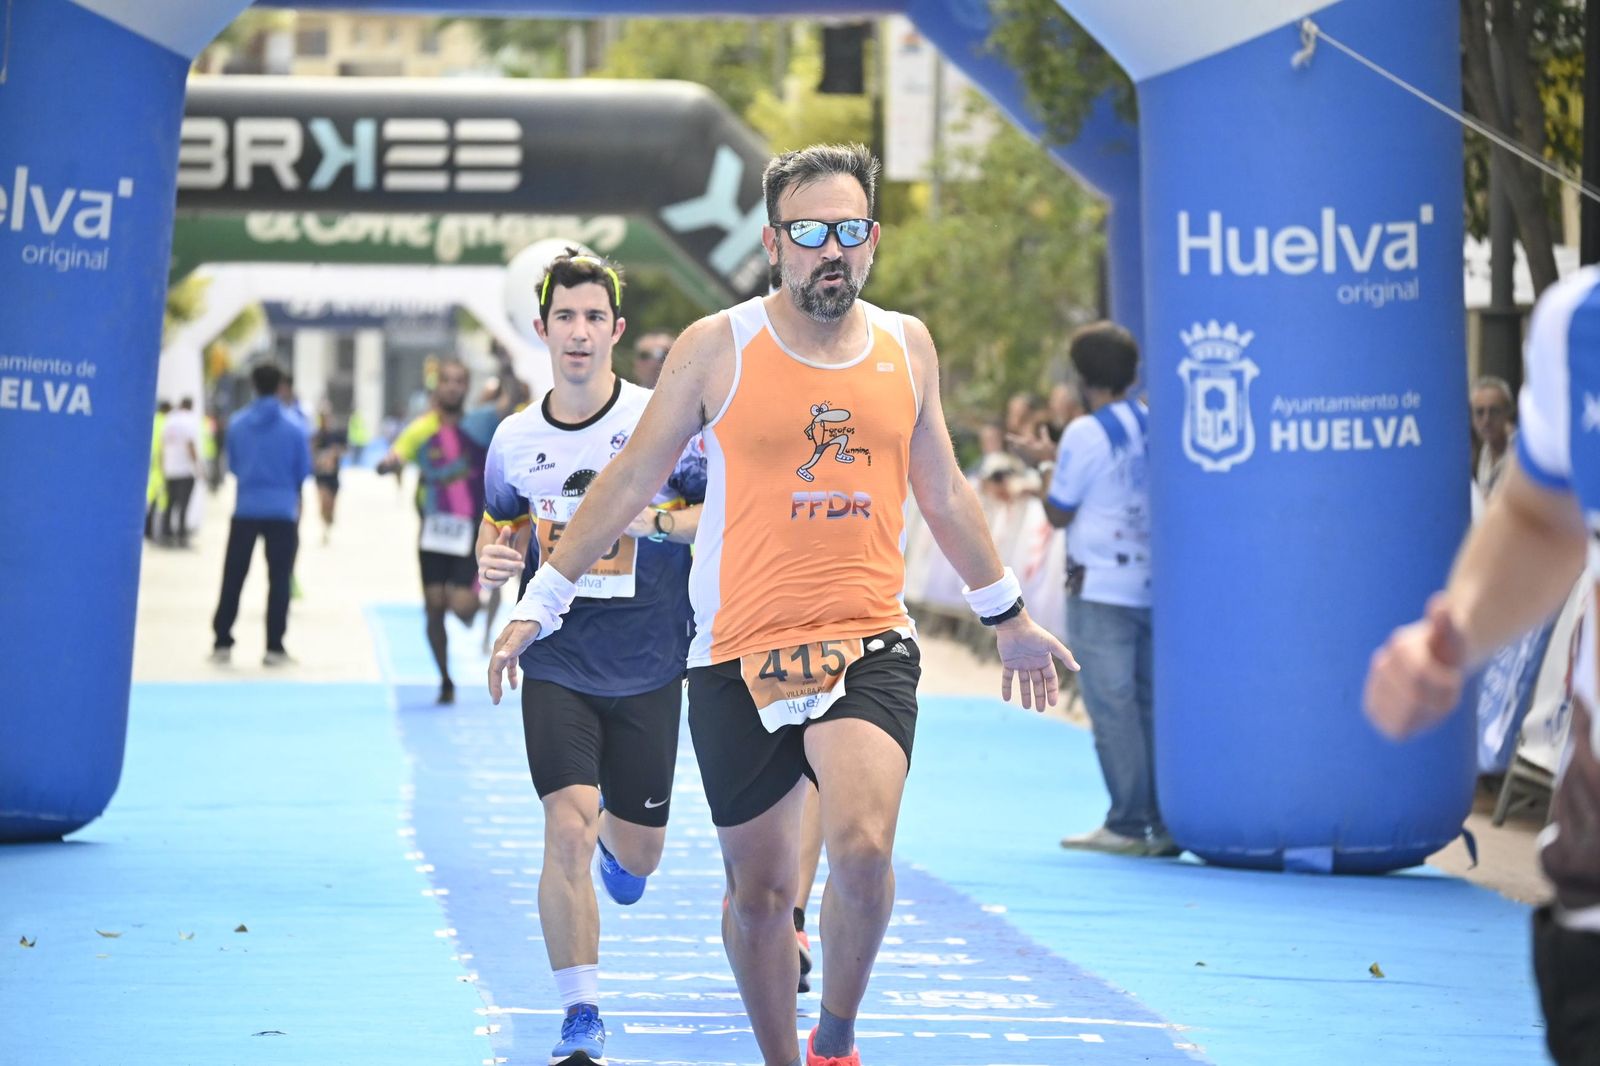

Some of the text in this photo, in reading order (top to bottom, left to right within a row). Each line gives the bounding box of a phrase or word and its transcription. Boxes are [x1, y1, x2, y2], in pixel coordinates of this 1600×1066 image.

[0, 166, 113, 241] lva
[1177, 206, 1419, 276] Huelva
[22, 243, 110, 273] original
[1337, 277, 1419, 308] original
[76, 359, 97, 379] de
[1271, 390, 1421, 417] Ayuntamiento de
[1270, 415, 1421, 452] HUELVA
[528, 462, 556, 474] VIATOR
[791, 490, 872, 520] FFDR
[758, 640, 846, 682] 415
